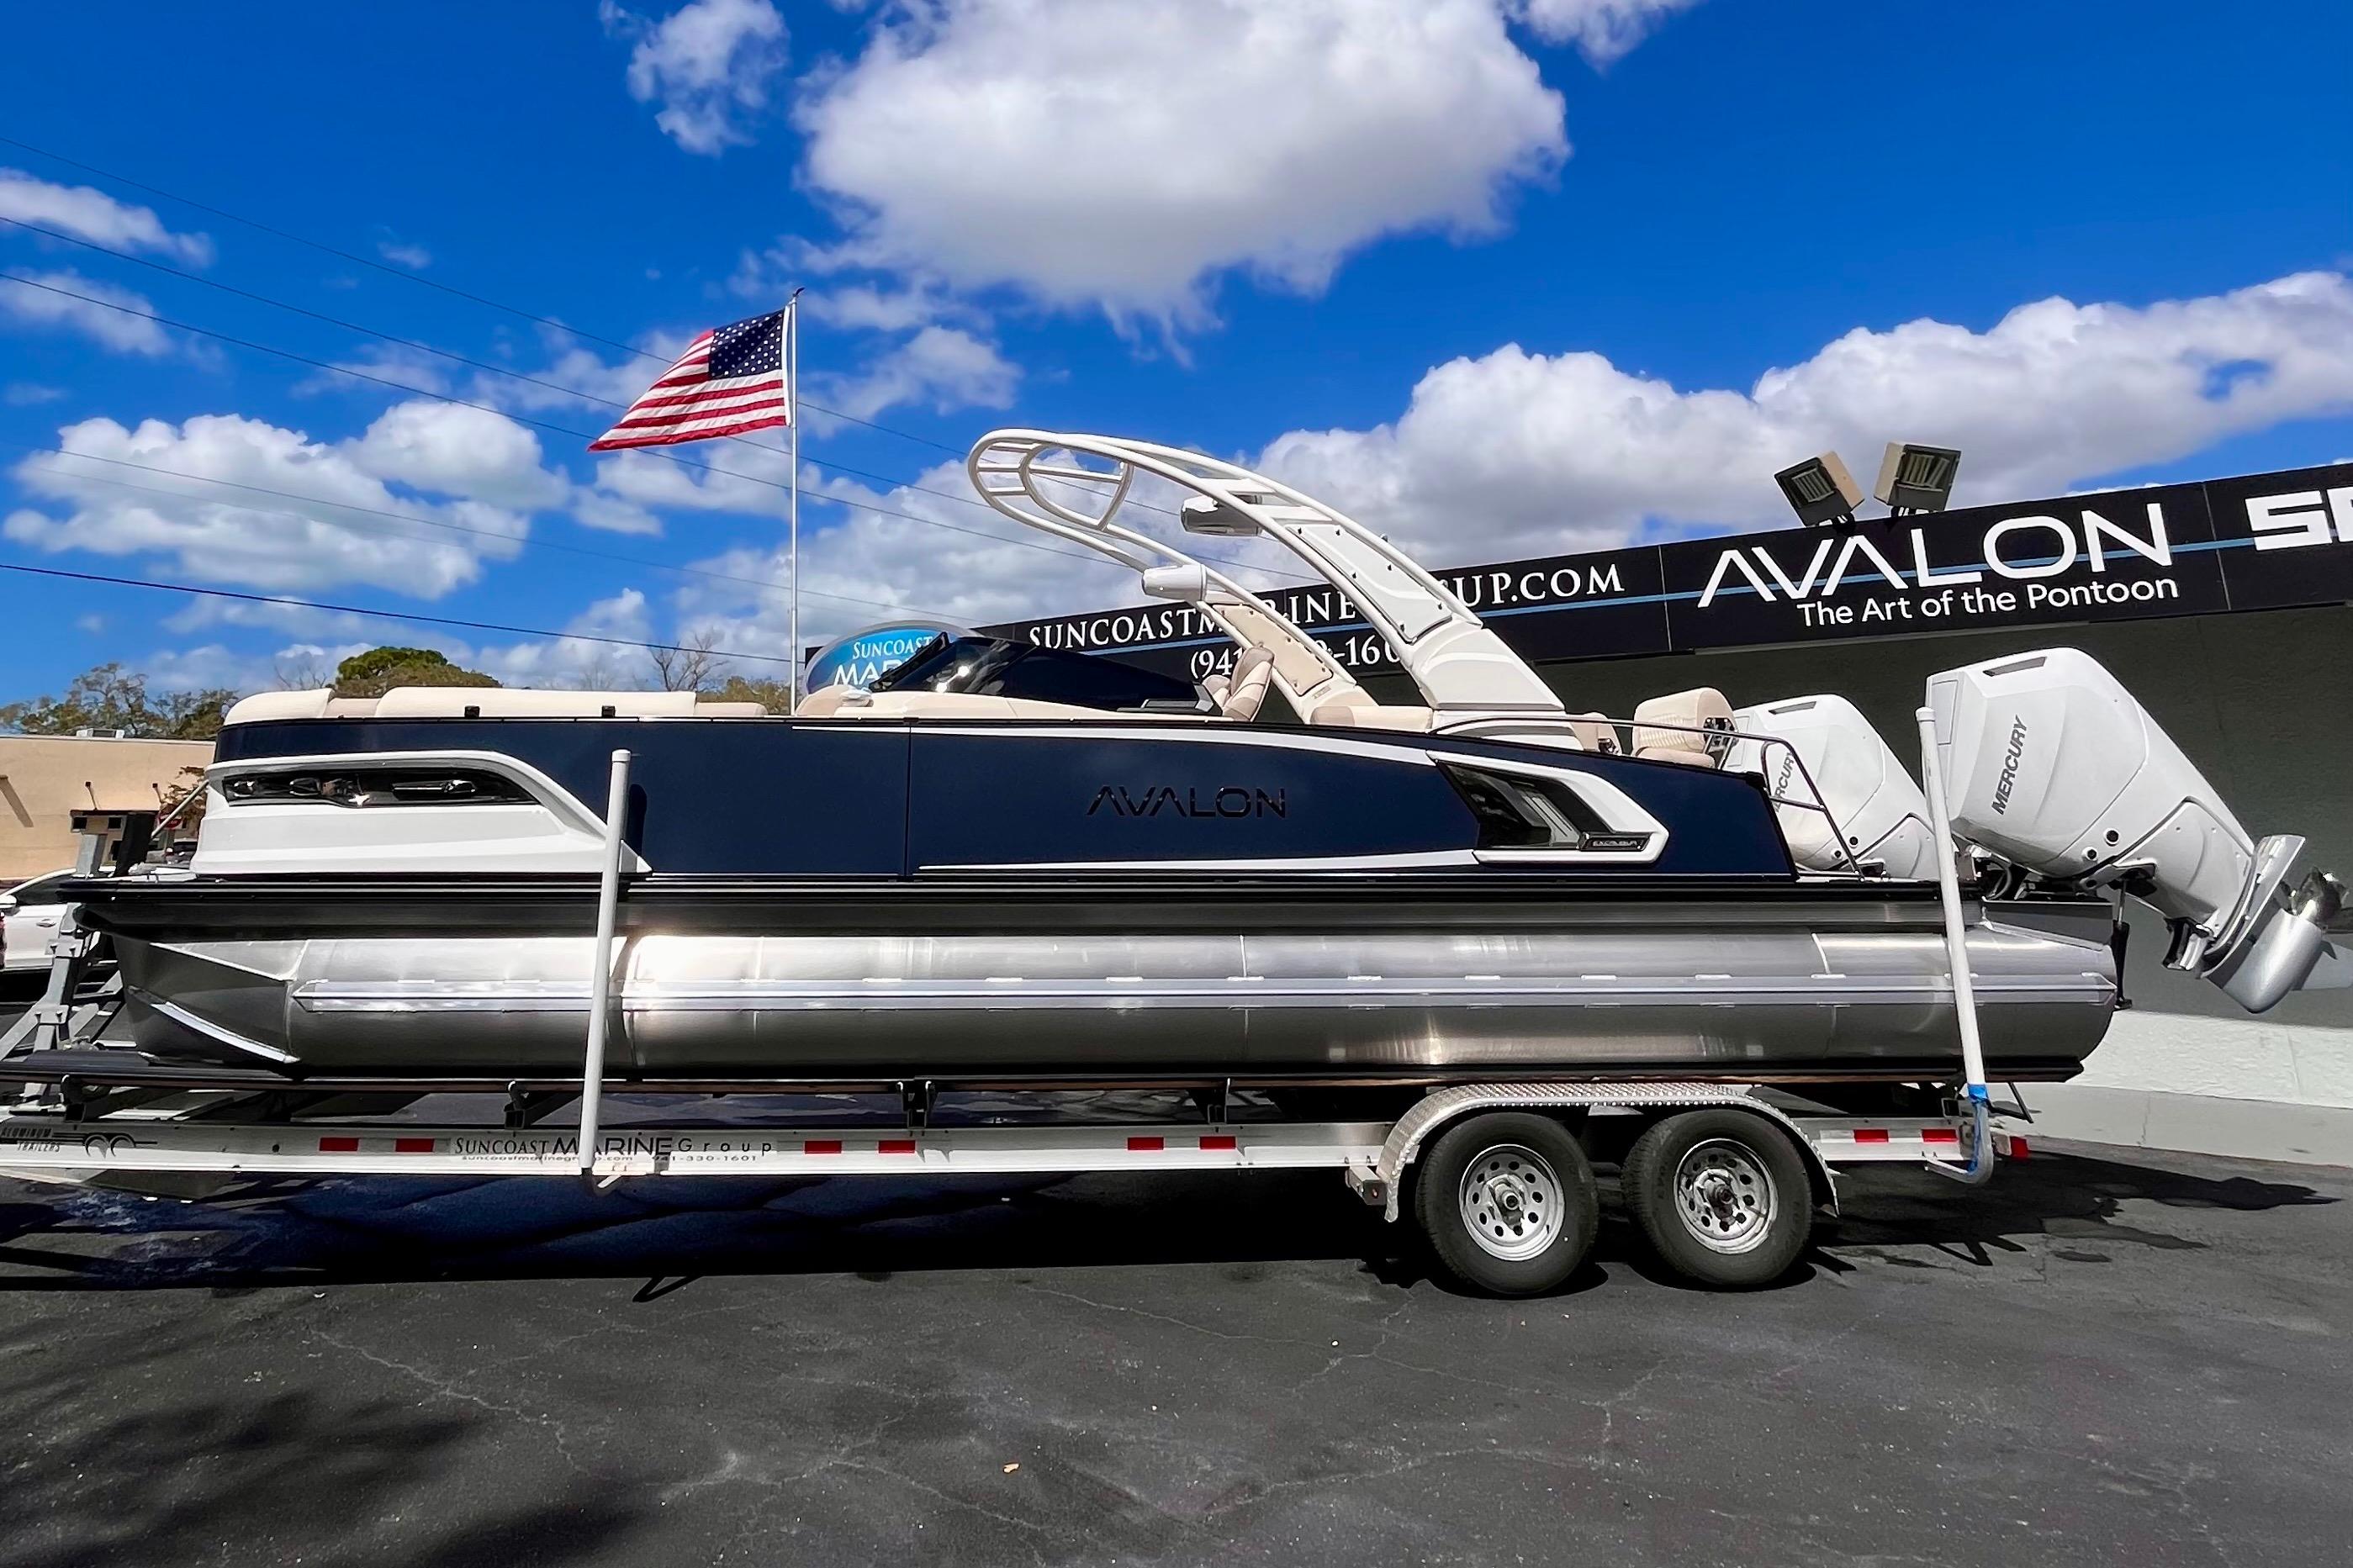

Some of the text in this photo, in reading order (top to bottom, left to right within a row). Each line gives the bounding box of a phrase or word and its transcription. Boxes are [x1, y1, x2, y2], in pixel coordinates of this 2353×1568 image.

[1697, 503, 2173, 609] AVALON
[1796, 578, 2179, 627] The Art of the Pontoon
[1991, 714, 2027, 816] MERCURY
[1086, 785, 1285, 818] AVALON
[454, 1137, 772, 1157] SUNCOAST MRINE Group
